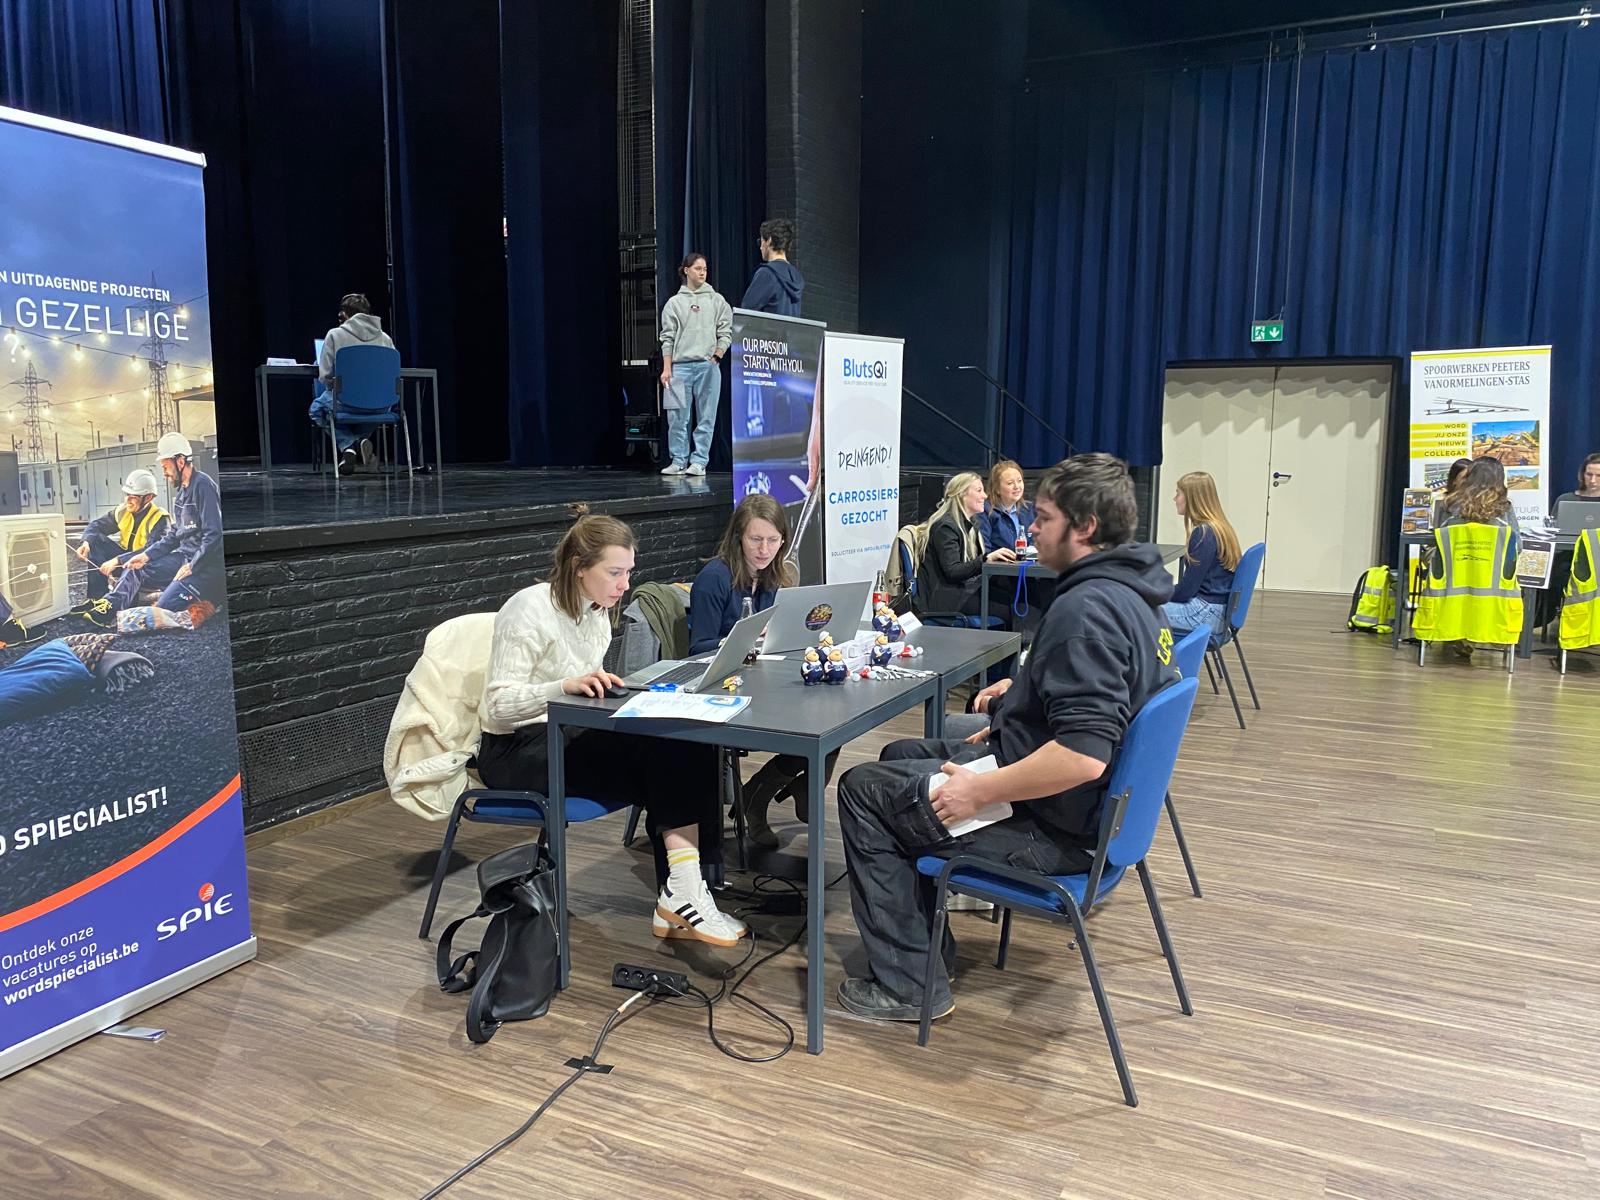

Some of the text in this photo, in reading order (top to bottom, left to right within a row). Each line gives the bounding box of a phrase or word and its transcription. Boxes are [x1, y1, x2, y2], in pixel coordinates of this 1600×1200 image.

[11, 271, 98, 294] UITDAGENDE
[100, 282, 171, 302] PROJECTEN
[15, 297, 190, 341] GEZELLIGE
[742, 337, 788, 356] OUR PASSION
[743, 354, 804, 373] STARTS WITH YOU.
[843, 358, 887, 379] BlutsQi
[1424, 361, 1531, 376] SPOORWERKEN PEETERS
[1424, 375, 1530, 389] VANORMELINGEN-STAS
[838, 444, 893, 471] DRINGEND!
[1424, 450, 1466, 458] COLLEGA?
[828, 488, 898, 504] CARROSSIERS
[841, 509, 888, 525] GEZOCHT
[14, 786, 168, 851] SPIECIALIST!
[156, 893, 234, 942] SPIE
[1, 926, 95, 970] Ontdek onze
[2, 942, 98, 988] vacatures op
[3, 942, 140, 1006] wordspiecialist.be
